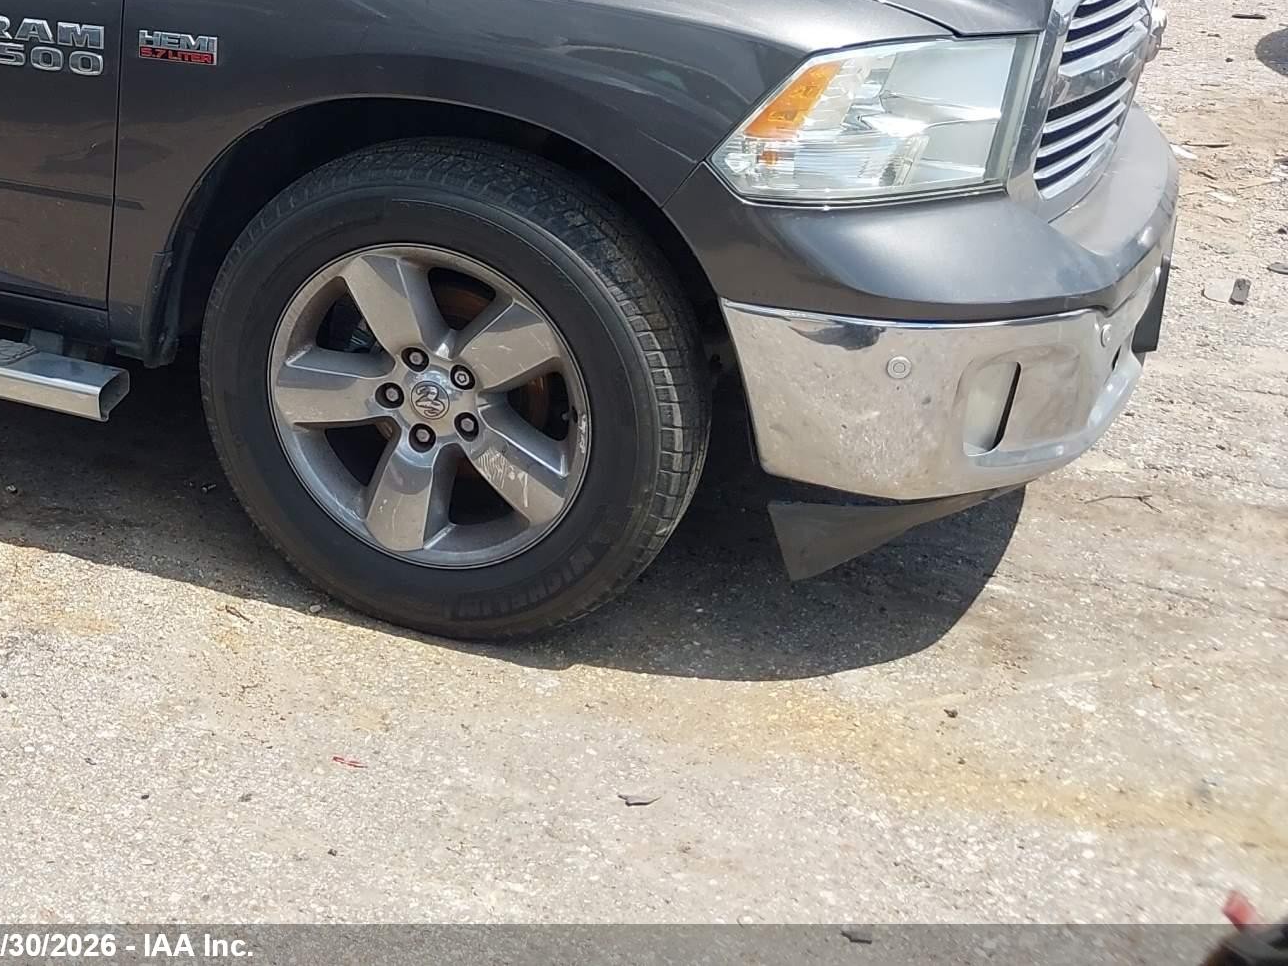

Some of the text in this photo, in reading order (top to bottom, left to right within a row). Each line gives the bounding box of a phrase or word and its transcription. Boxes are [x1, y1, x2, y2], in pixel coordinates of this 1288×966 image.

[139, 30, 218, 53] HEMI
[140, 47, 213, 64] 5.7 LITER
